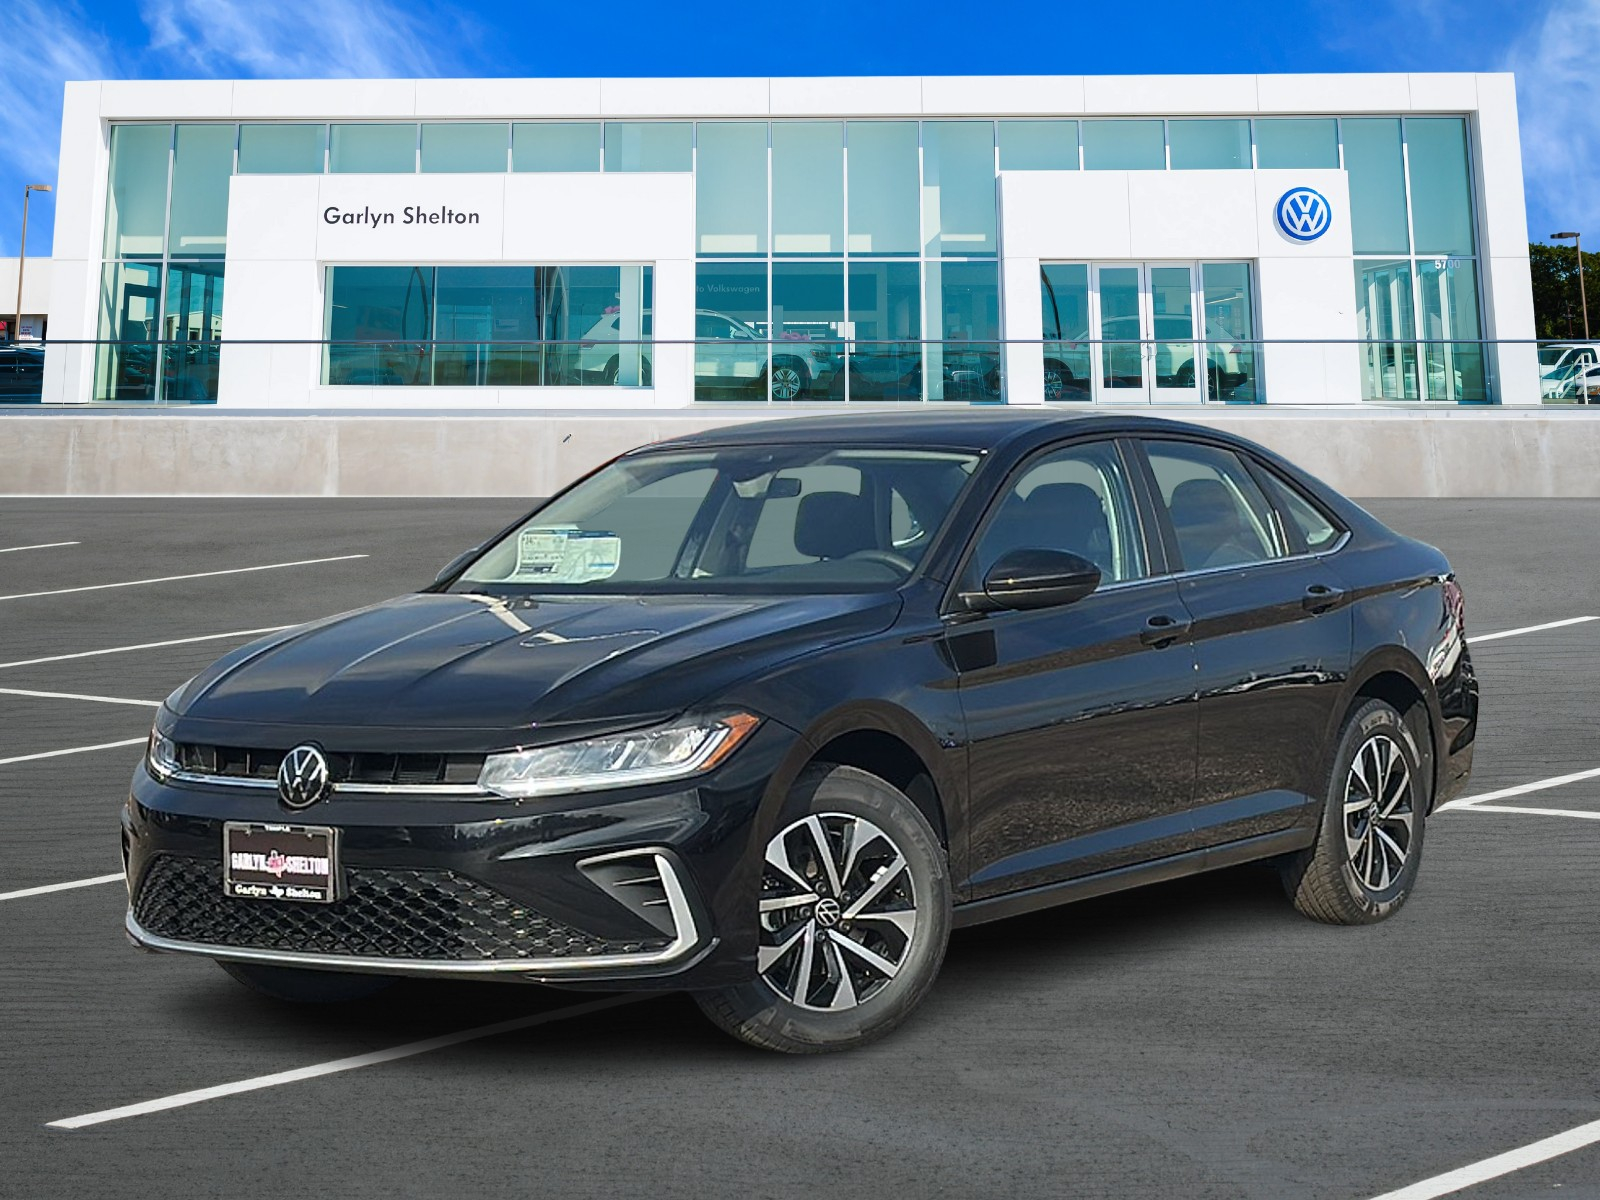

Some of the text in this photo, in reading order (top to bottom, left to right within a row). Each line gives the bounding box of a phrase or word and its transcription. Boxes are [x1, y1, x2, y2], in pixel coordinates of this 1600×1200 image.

[323, 206, 480, 229] Garlyn Shelton
[1434, 260, 1461, 270] 5700
[707, 284, 760, 295] Volkswagen
[285, 855, 329, 875] SHELTON
